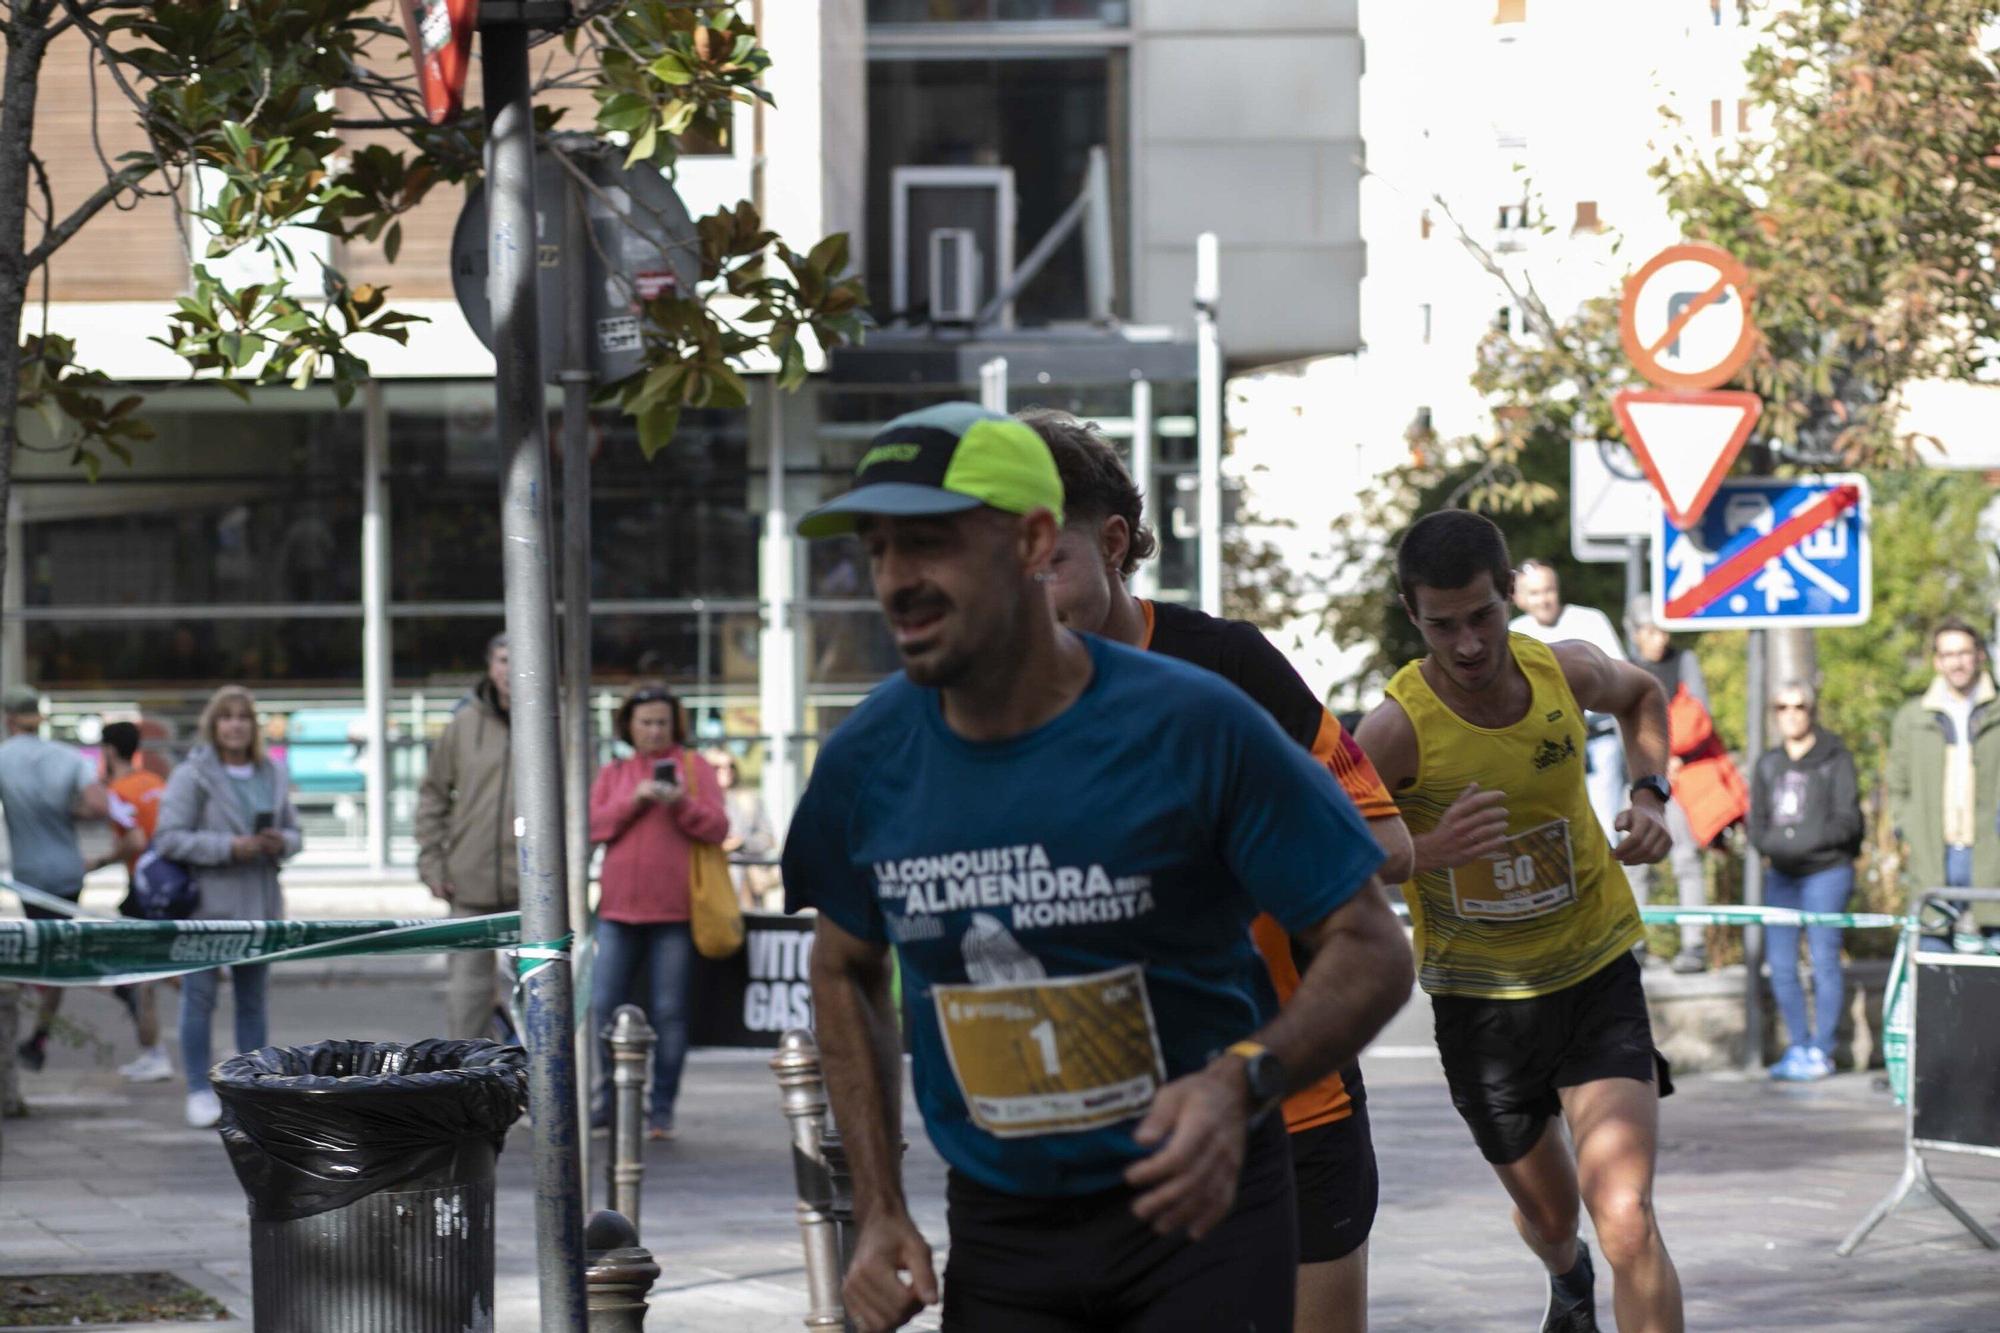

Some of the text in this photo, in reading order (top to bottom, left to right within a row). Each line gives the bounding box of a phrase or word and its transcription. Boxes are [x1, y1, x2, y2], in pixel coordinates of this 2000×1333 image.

[873, 844, 1050, 884] LA CONQUISTA
[1493, 854, 1535, 890] 50
[905, 865, 1113, 915] ALMENDRA
[1012, 891, 1154, 928] KONKISTA
[1030, 1019, 1062, 1075] 1
